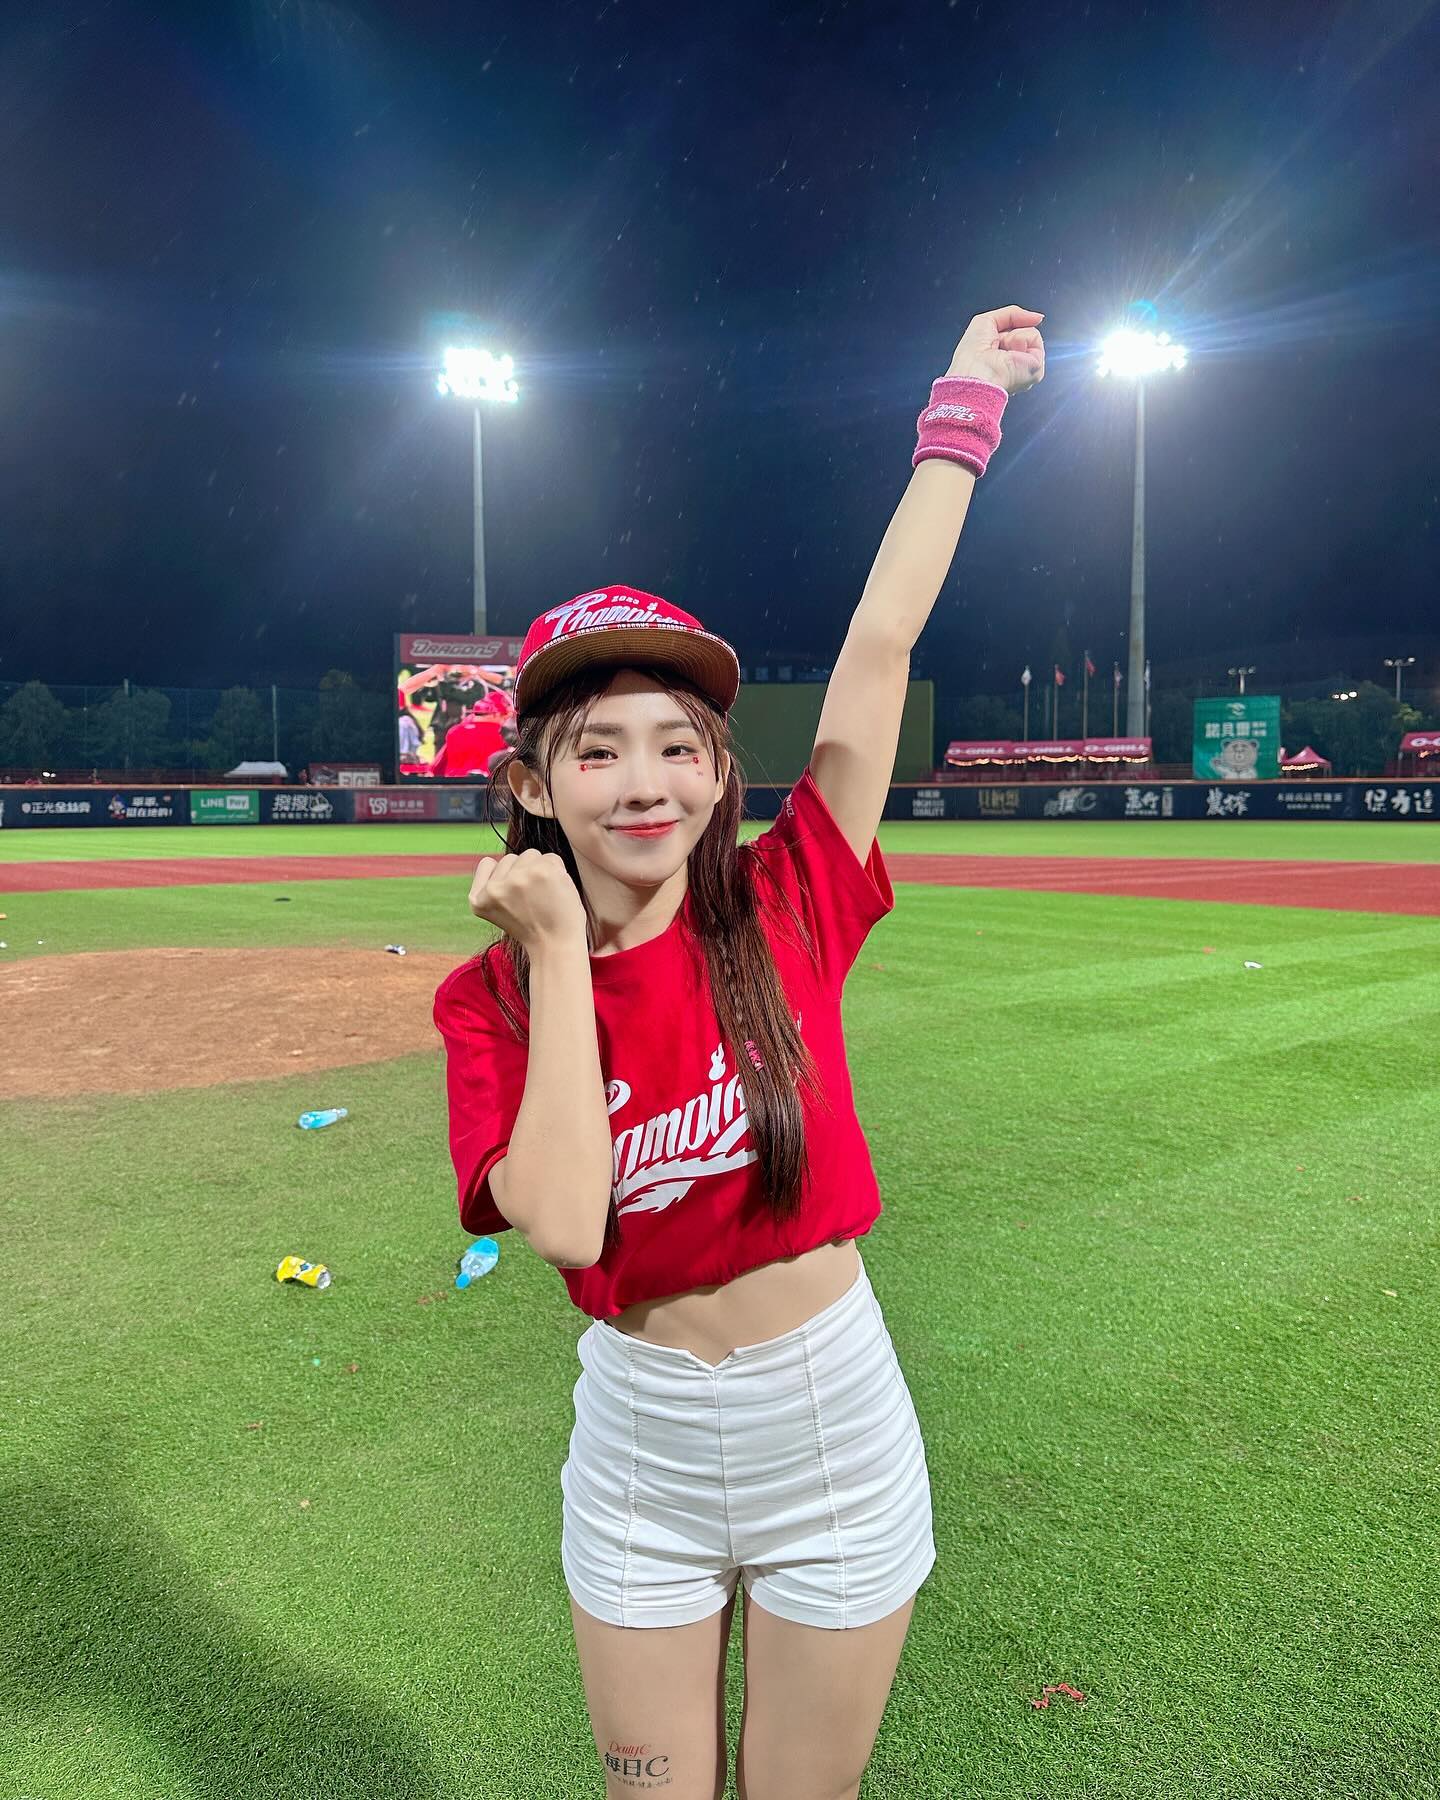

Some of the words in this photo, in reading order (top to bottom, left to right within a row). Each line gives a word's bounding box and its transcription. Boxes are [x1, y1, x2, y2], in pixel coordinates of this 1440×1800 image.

[924, 410, 978, 422] BEAUTIES
[409, 639, 503, 658] DRAGONS
[200, 798, 225, 809] LINE
